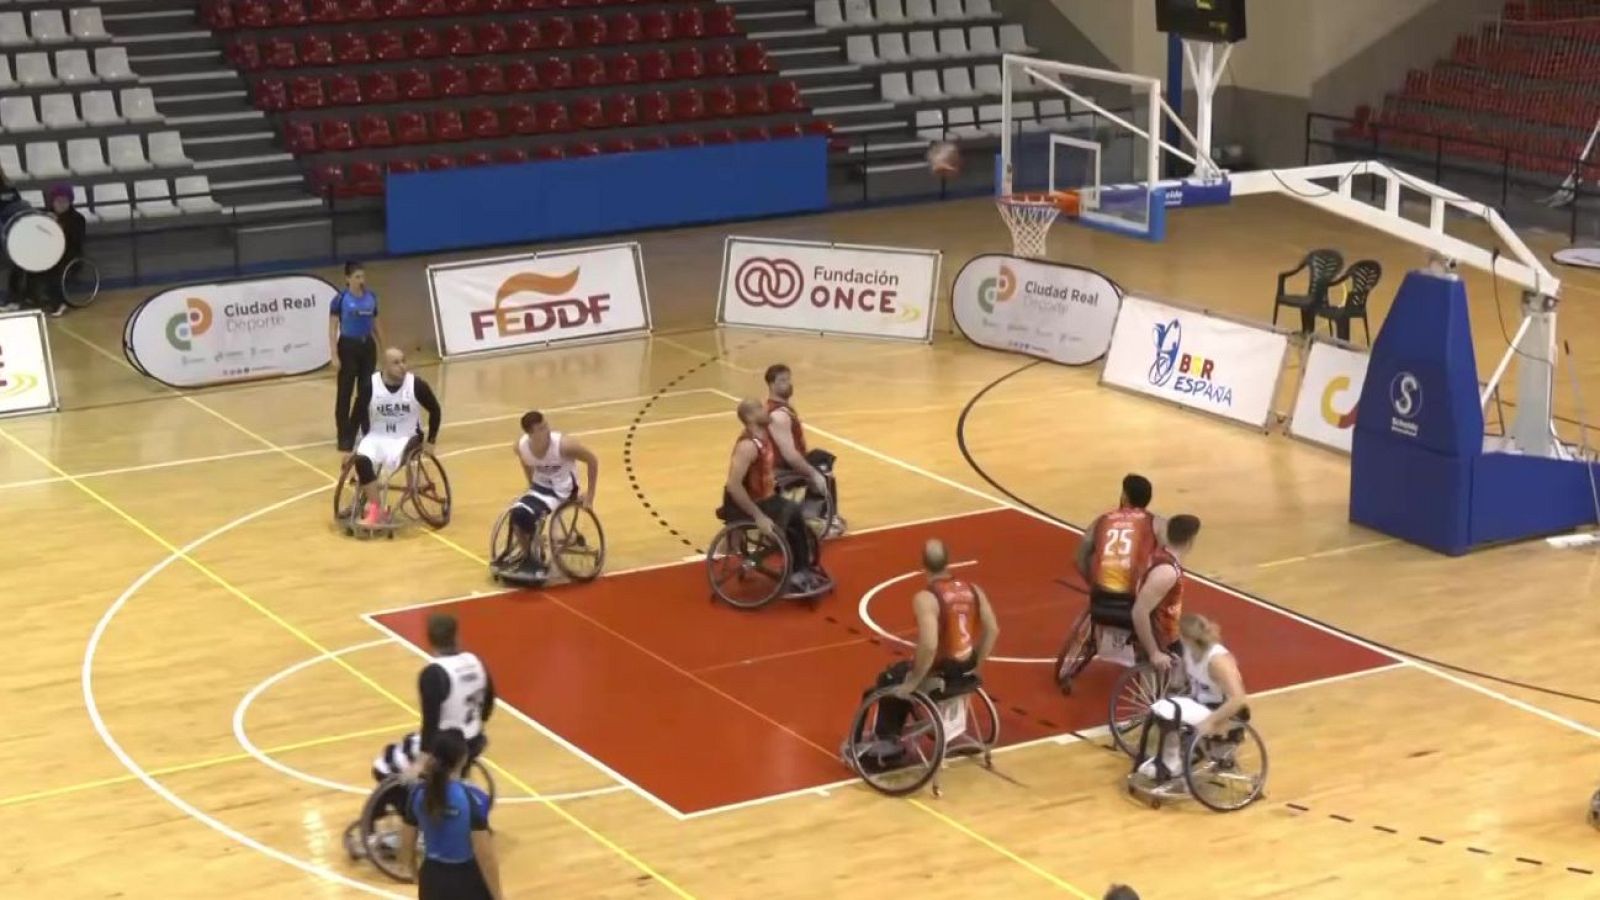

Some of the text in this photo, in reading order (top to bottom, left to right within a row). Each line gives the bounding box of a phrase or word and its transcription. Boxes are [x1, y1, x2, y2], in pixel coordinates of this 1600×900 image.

[814, 266, 899, 286] Fundación
[224, 295, 316, 318] Ciudad Real
[810, 285, 897, 313] ONCE
[1025, 281, 1099, 306] Ciudad Real
[226, 315, 286, 334] Deporte
[471, 294, 610, 340] FEDDF
[1174, 376, 1232, 406] ESPAÑA
[1104, 529, 1135, 556] 25
